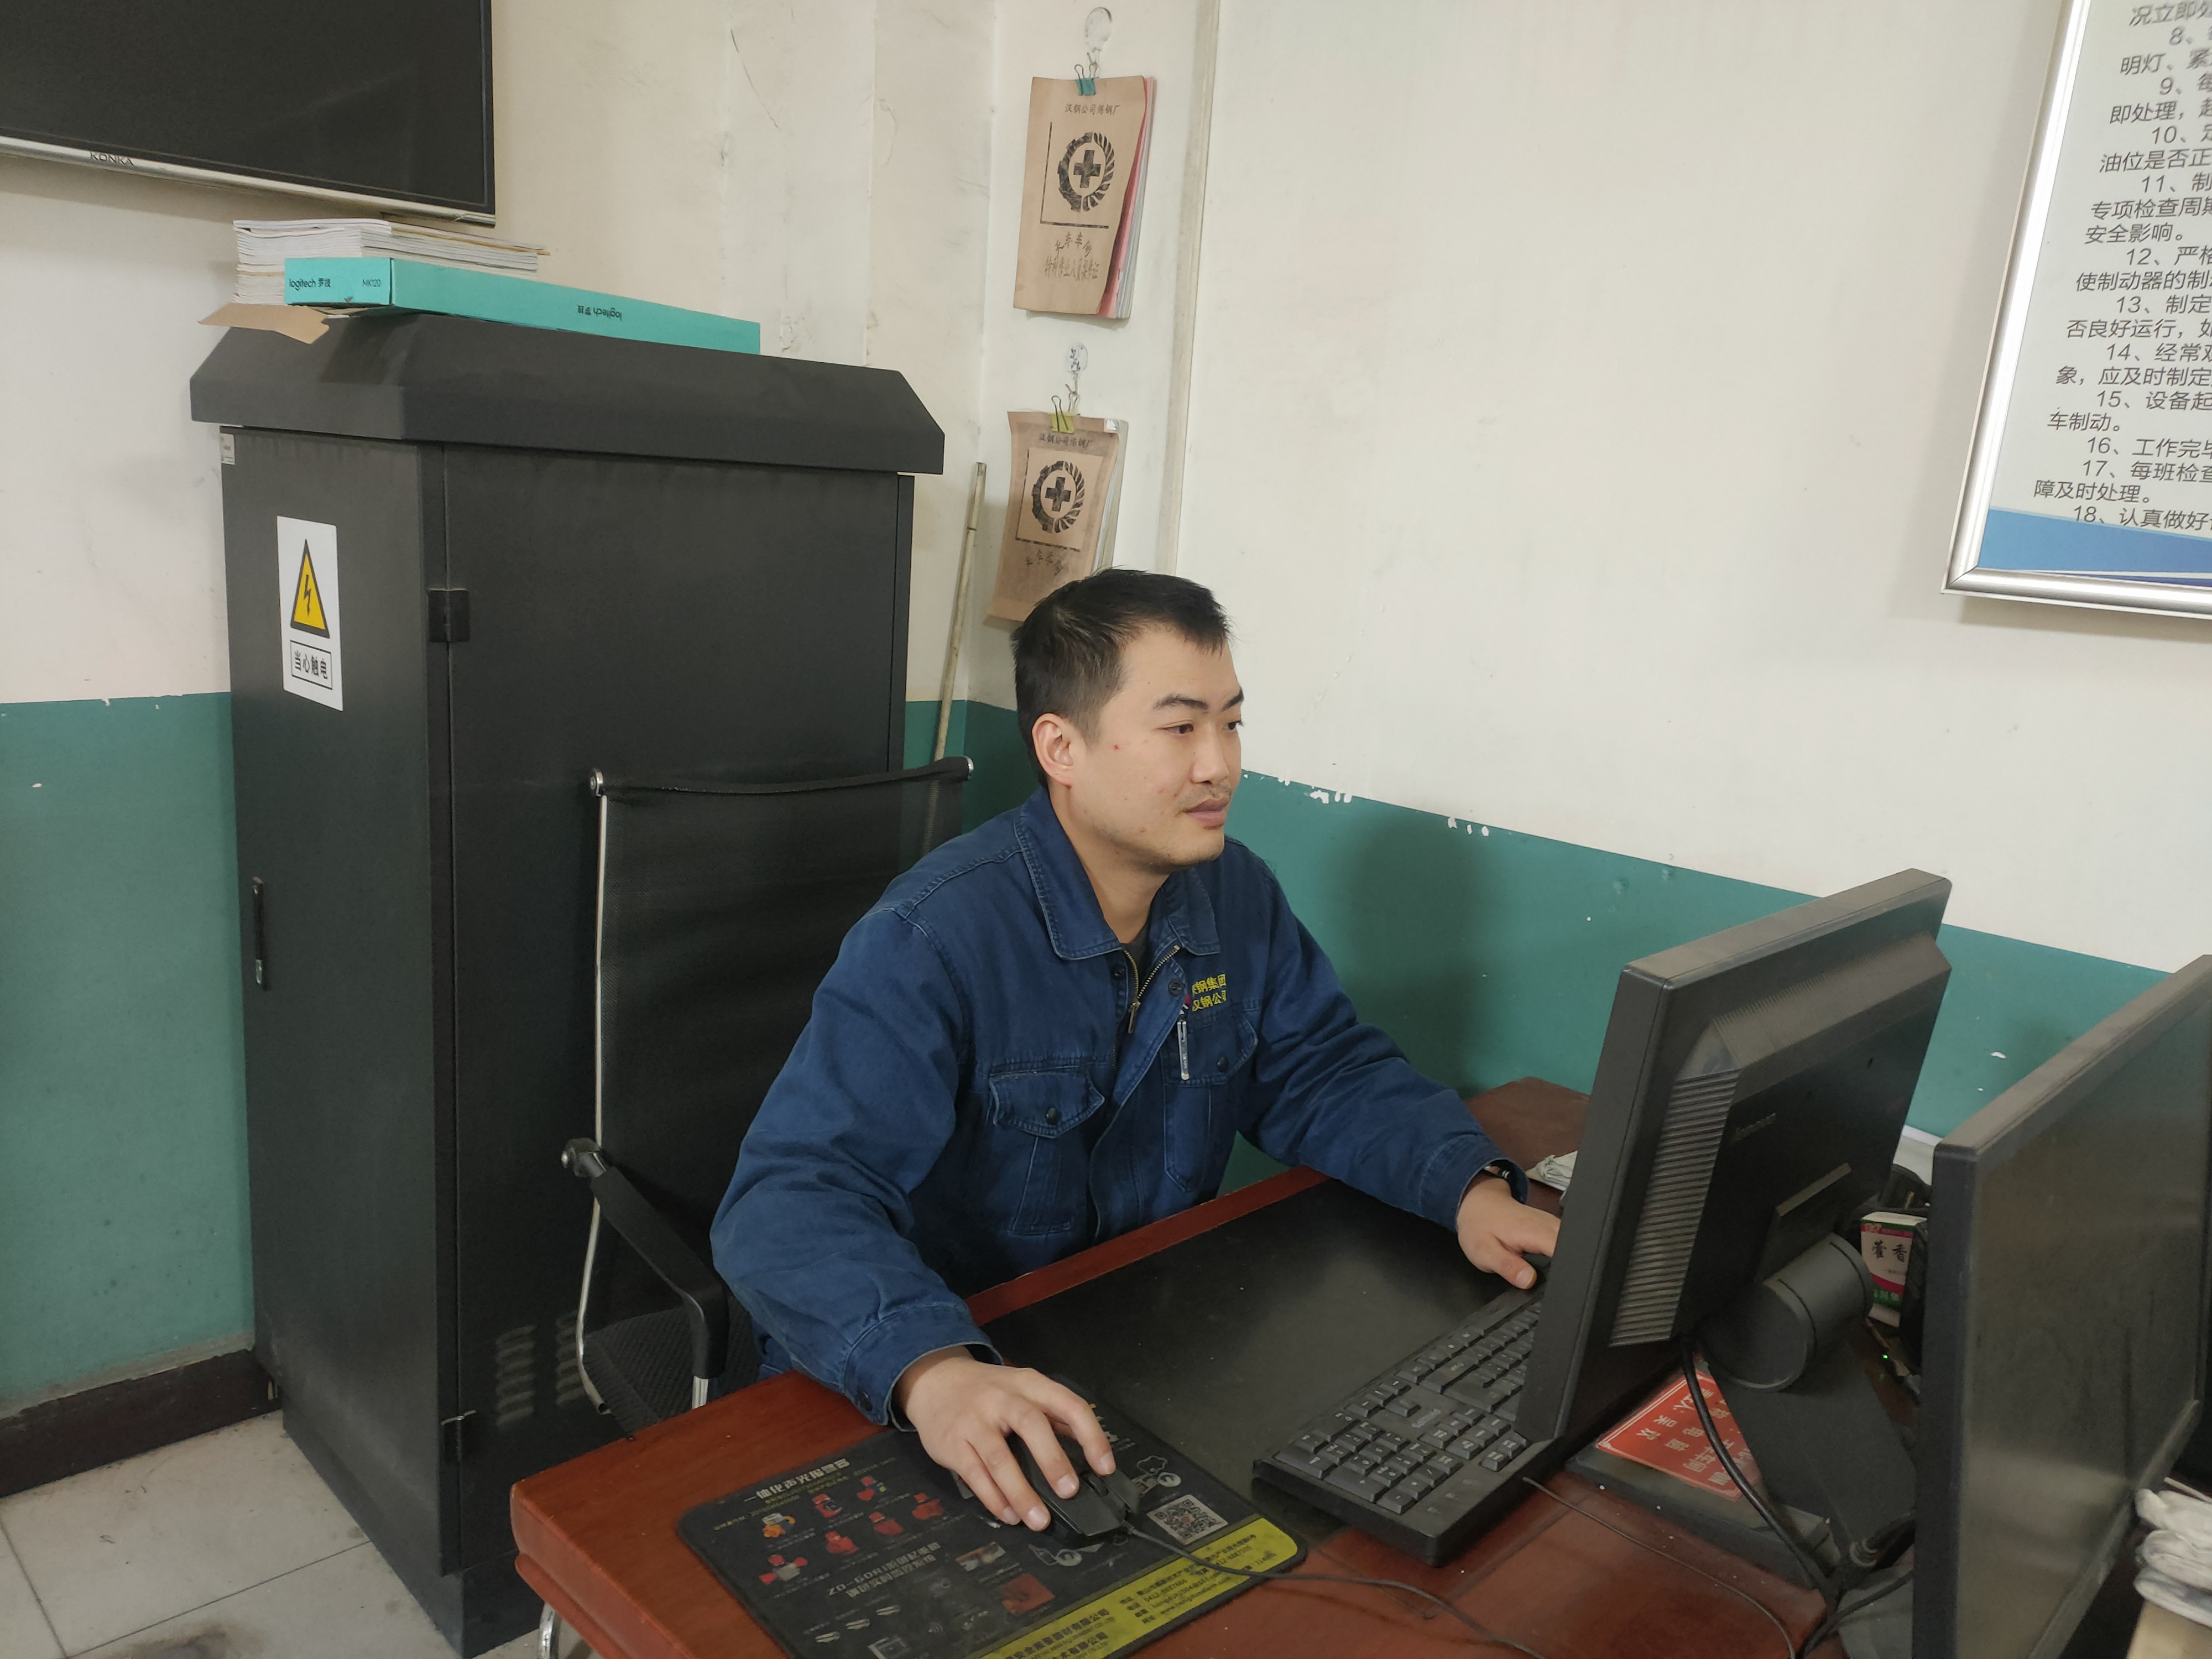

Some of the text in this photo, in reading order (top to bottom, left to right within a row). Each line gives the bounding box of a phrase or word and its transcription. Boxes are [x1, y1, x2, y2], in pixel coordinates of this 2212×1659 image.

[2169, 26, 2212, 45] 8、
[90, 150, 134, 166] KONKA
[2099, 148, 2212, 173] 油位是否正
[2085, 222, 2184, 244] 安全影响。
[289, 278, 316, 291] logitech
[2076, 270, 2212, 292] 使制动器的制
[2116, 294, 2212, 315] 13、制定
[2047, 411, 2121, 432] 车制动。
[2033, 479, 2151, 504] 障及时处理。
[294, 650, 328, 680] 当心触电
